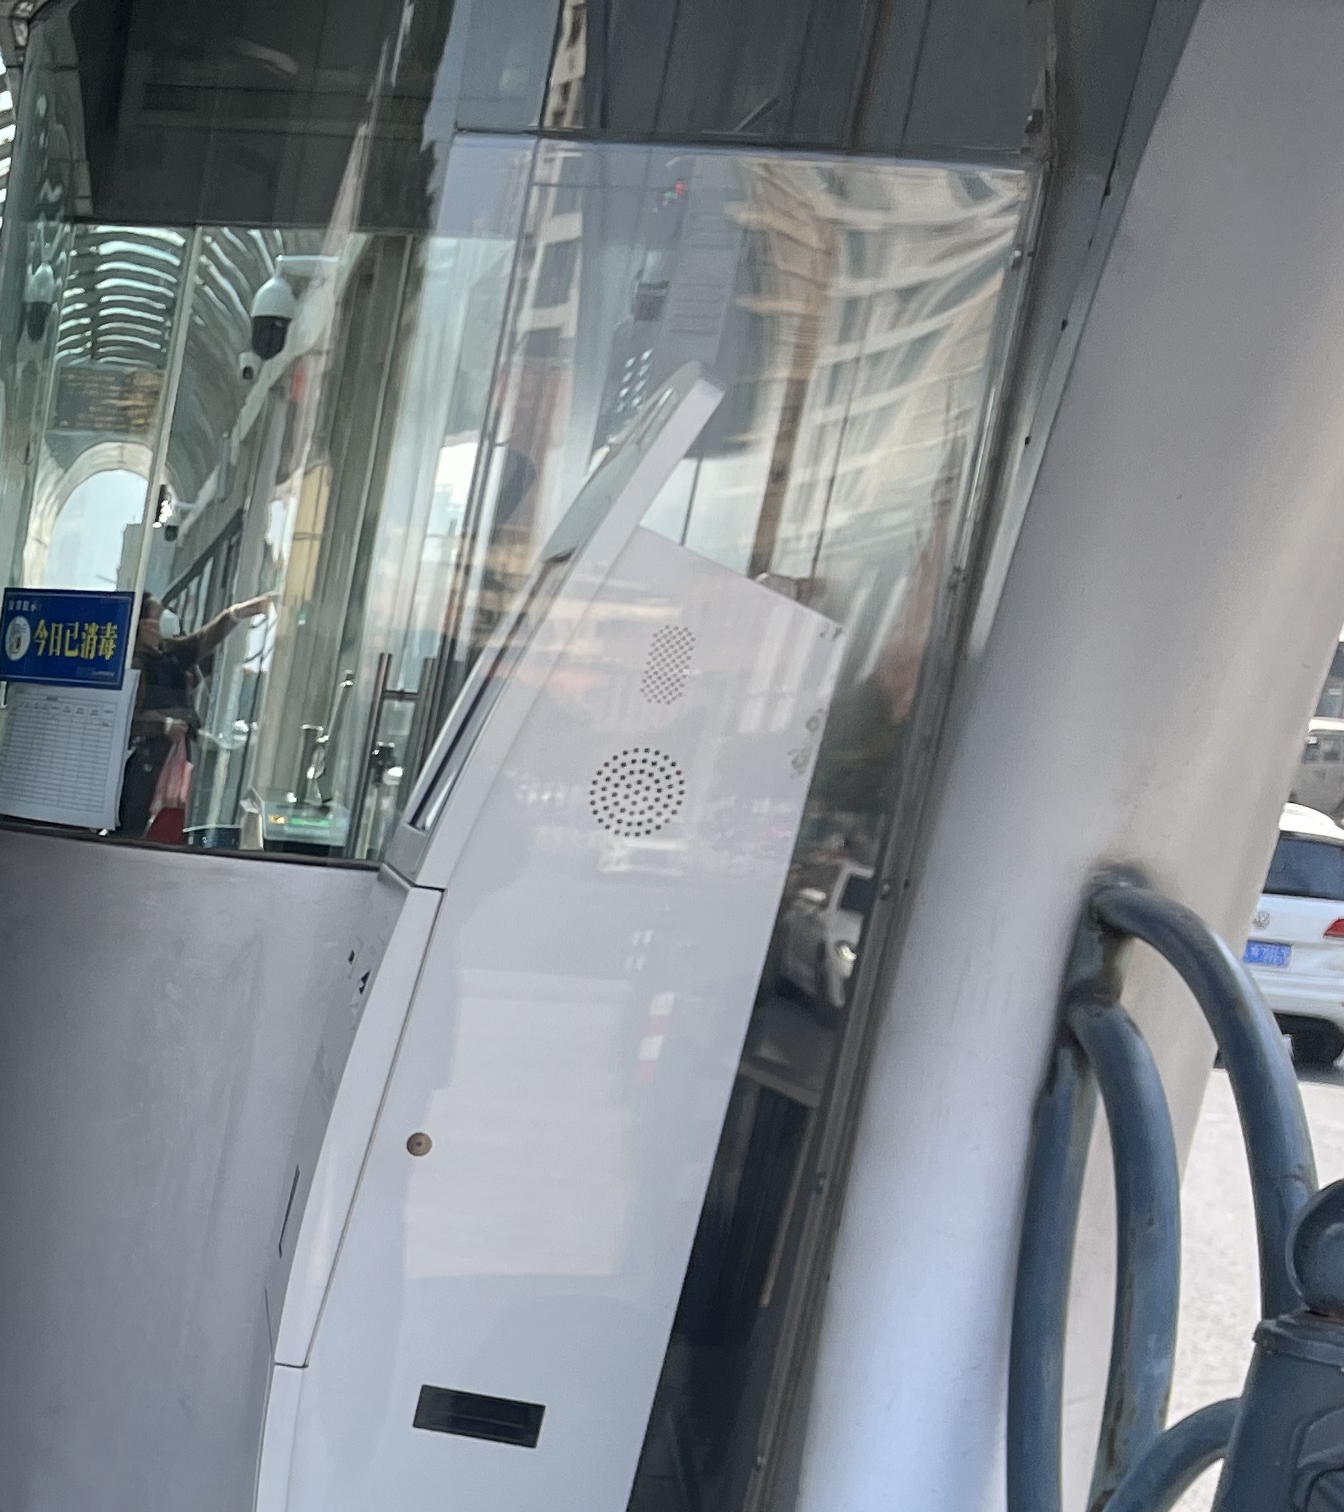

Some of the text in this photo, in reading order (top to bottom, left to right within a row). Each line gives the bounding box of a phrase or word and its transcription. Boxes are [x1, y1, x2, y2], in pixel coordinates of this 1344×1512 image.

[33, 619, 118, 660] 今日已消毒
